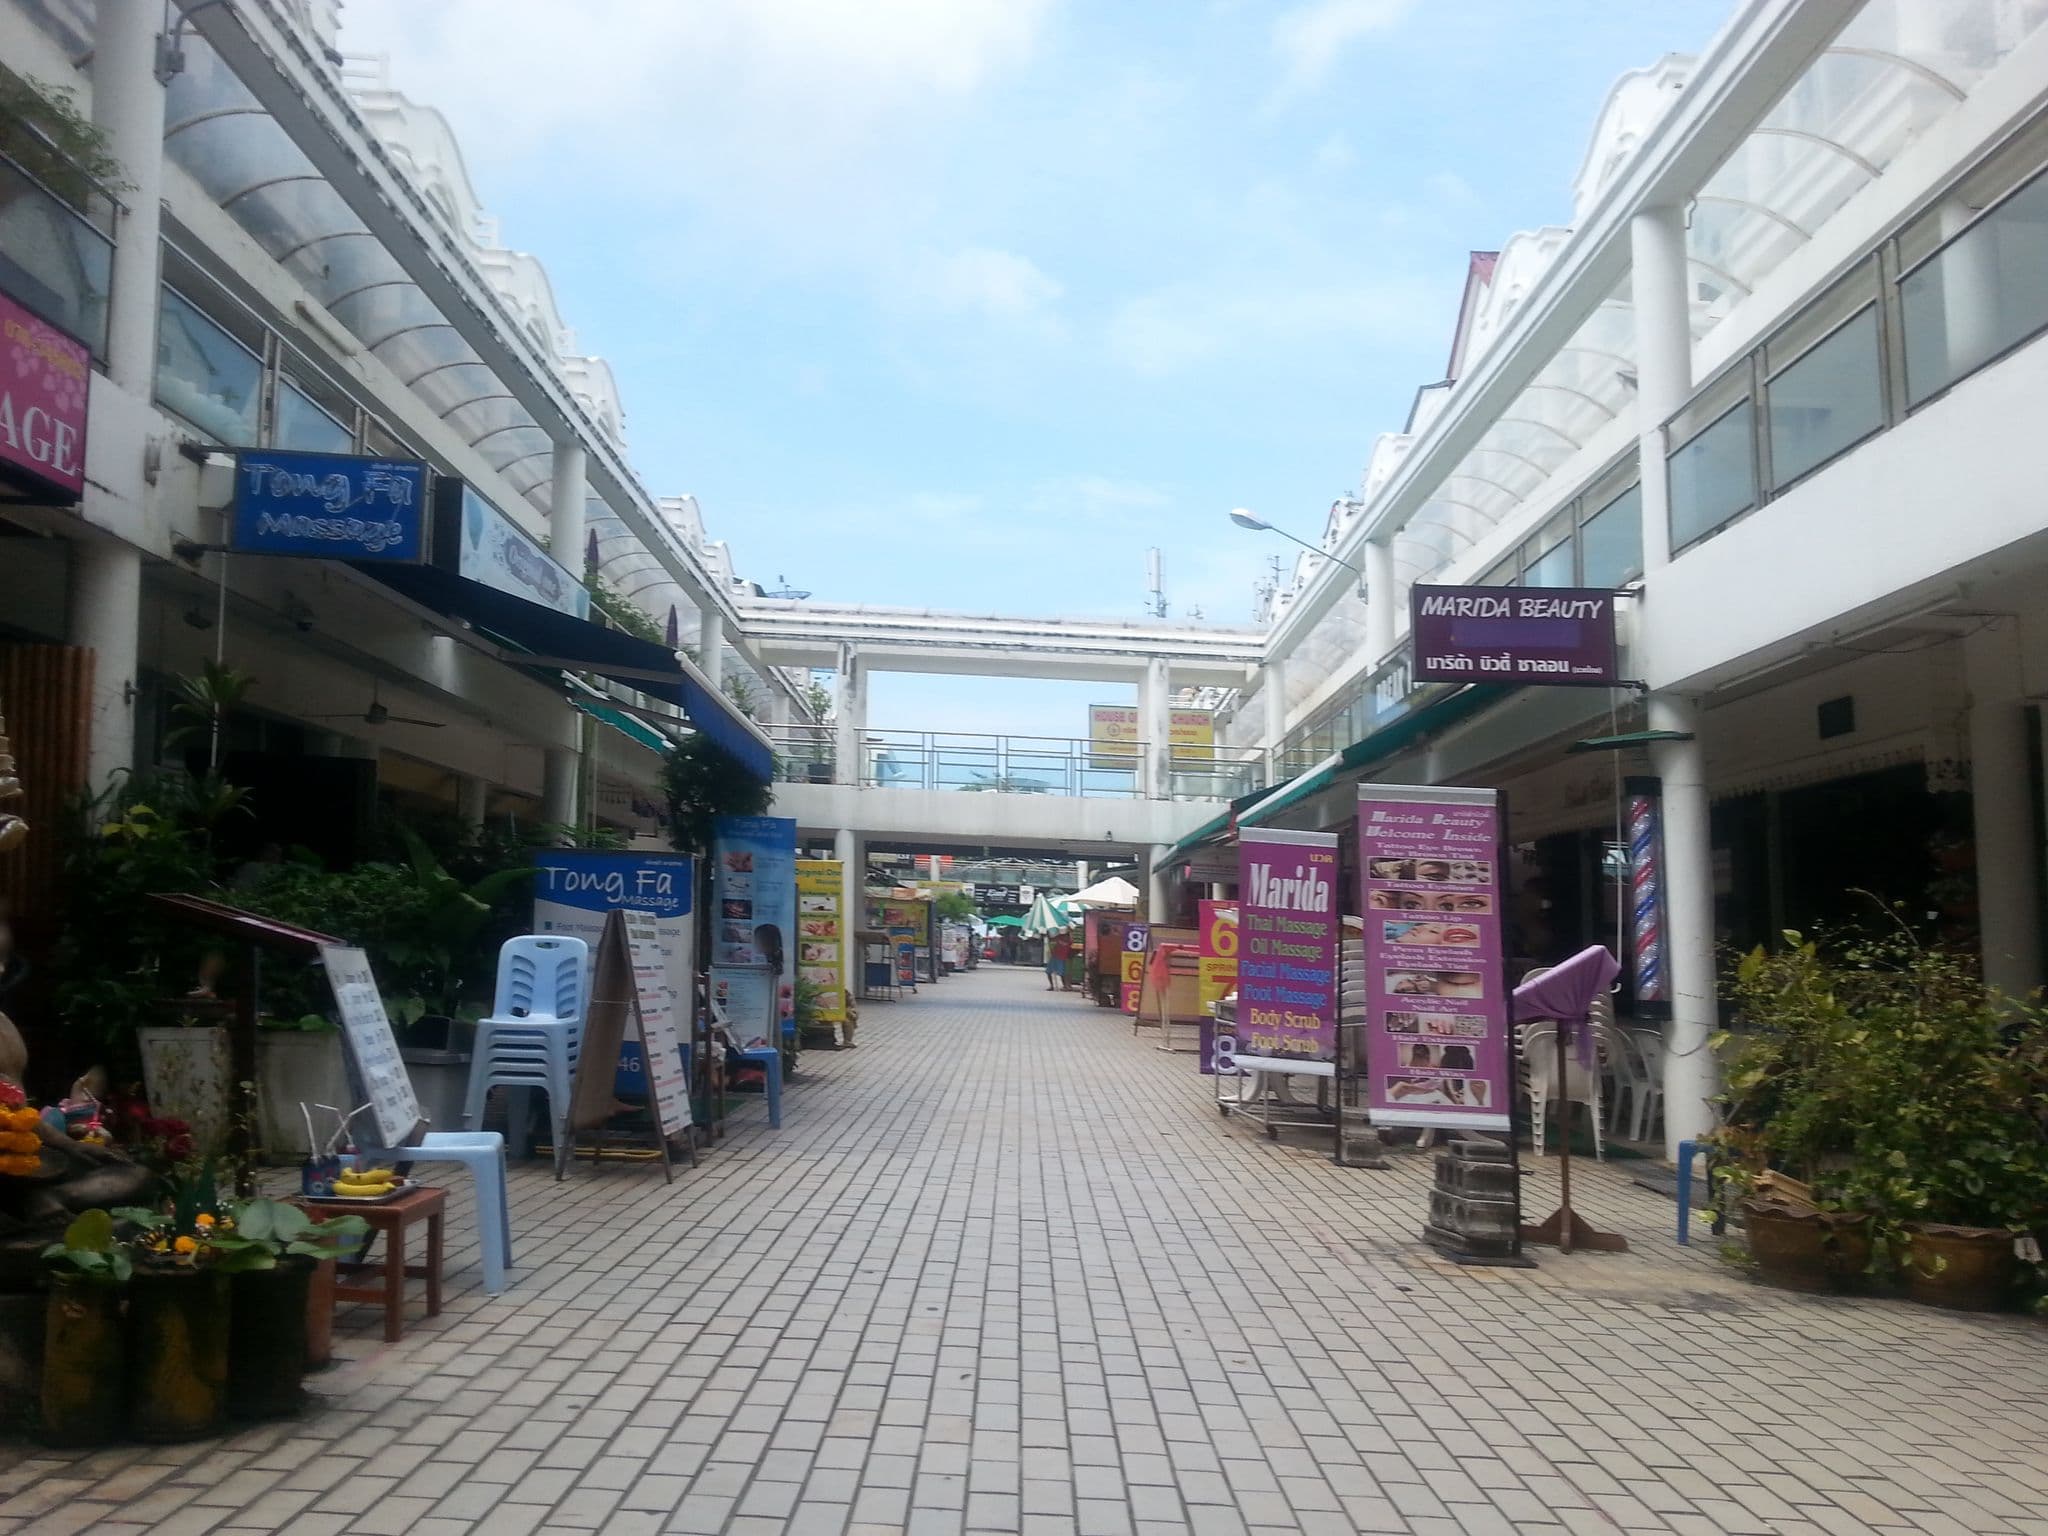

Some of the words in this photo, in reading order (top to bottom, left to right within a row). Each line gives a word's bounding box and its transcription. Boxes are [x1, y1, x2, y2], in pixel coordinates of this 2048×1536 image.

[242, 463, 350, 514] Tong
[256, 512, 403, 552] Massage
[1421, 596, 1511, 618] MARIDA
[1518, 598, 1603, 619] BEAUTY
[1371, 810, 1424, 824] Marida
[1432, 813, 1485, 829] Beauty
[1366, 825, 1436, 840] Welcome
[1443, 829, 1492, 842] Inside
[545, 866, 624, 903] Tong
[636, 870, 672, 895] Fa
[1246, 863, 1329, 912] Marida
[622, 895, 680, 911] Massage
[1247, 914, 1273, 931] Thai
[1275, 916, 1328, 939] Massage
[1271, 940, 1323, 962] Massage
[1241, 960, 1276, 978] Facial
[1279, 963, 1331, 986] Massage
[1244, 984, 1272, 1001] Foot
[1275, 986, 1328, 1009] Massage
[1250, 1008, 1281, 1031] Body
[1284, 1011, 1320, 1029] Scrub
[1252, 1032, 1281, 1049] Foot
[1283, 1034, 1319, 1053] Scrub
